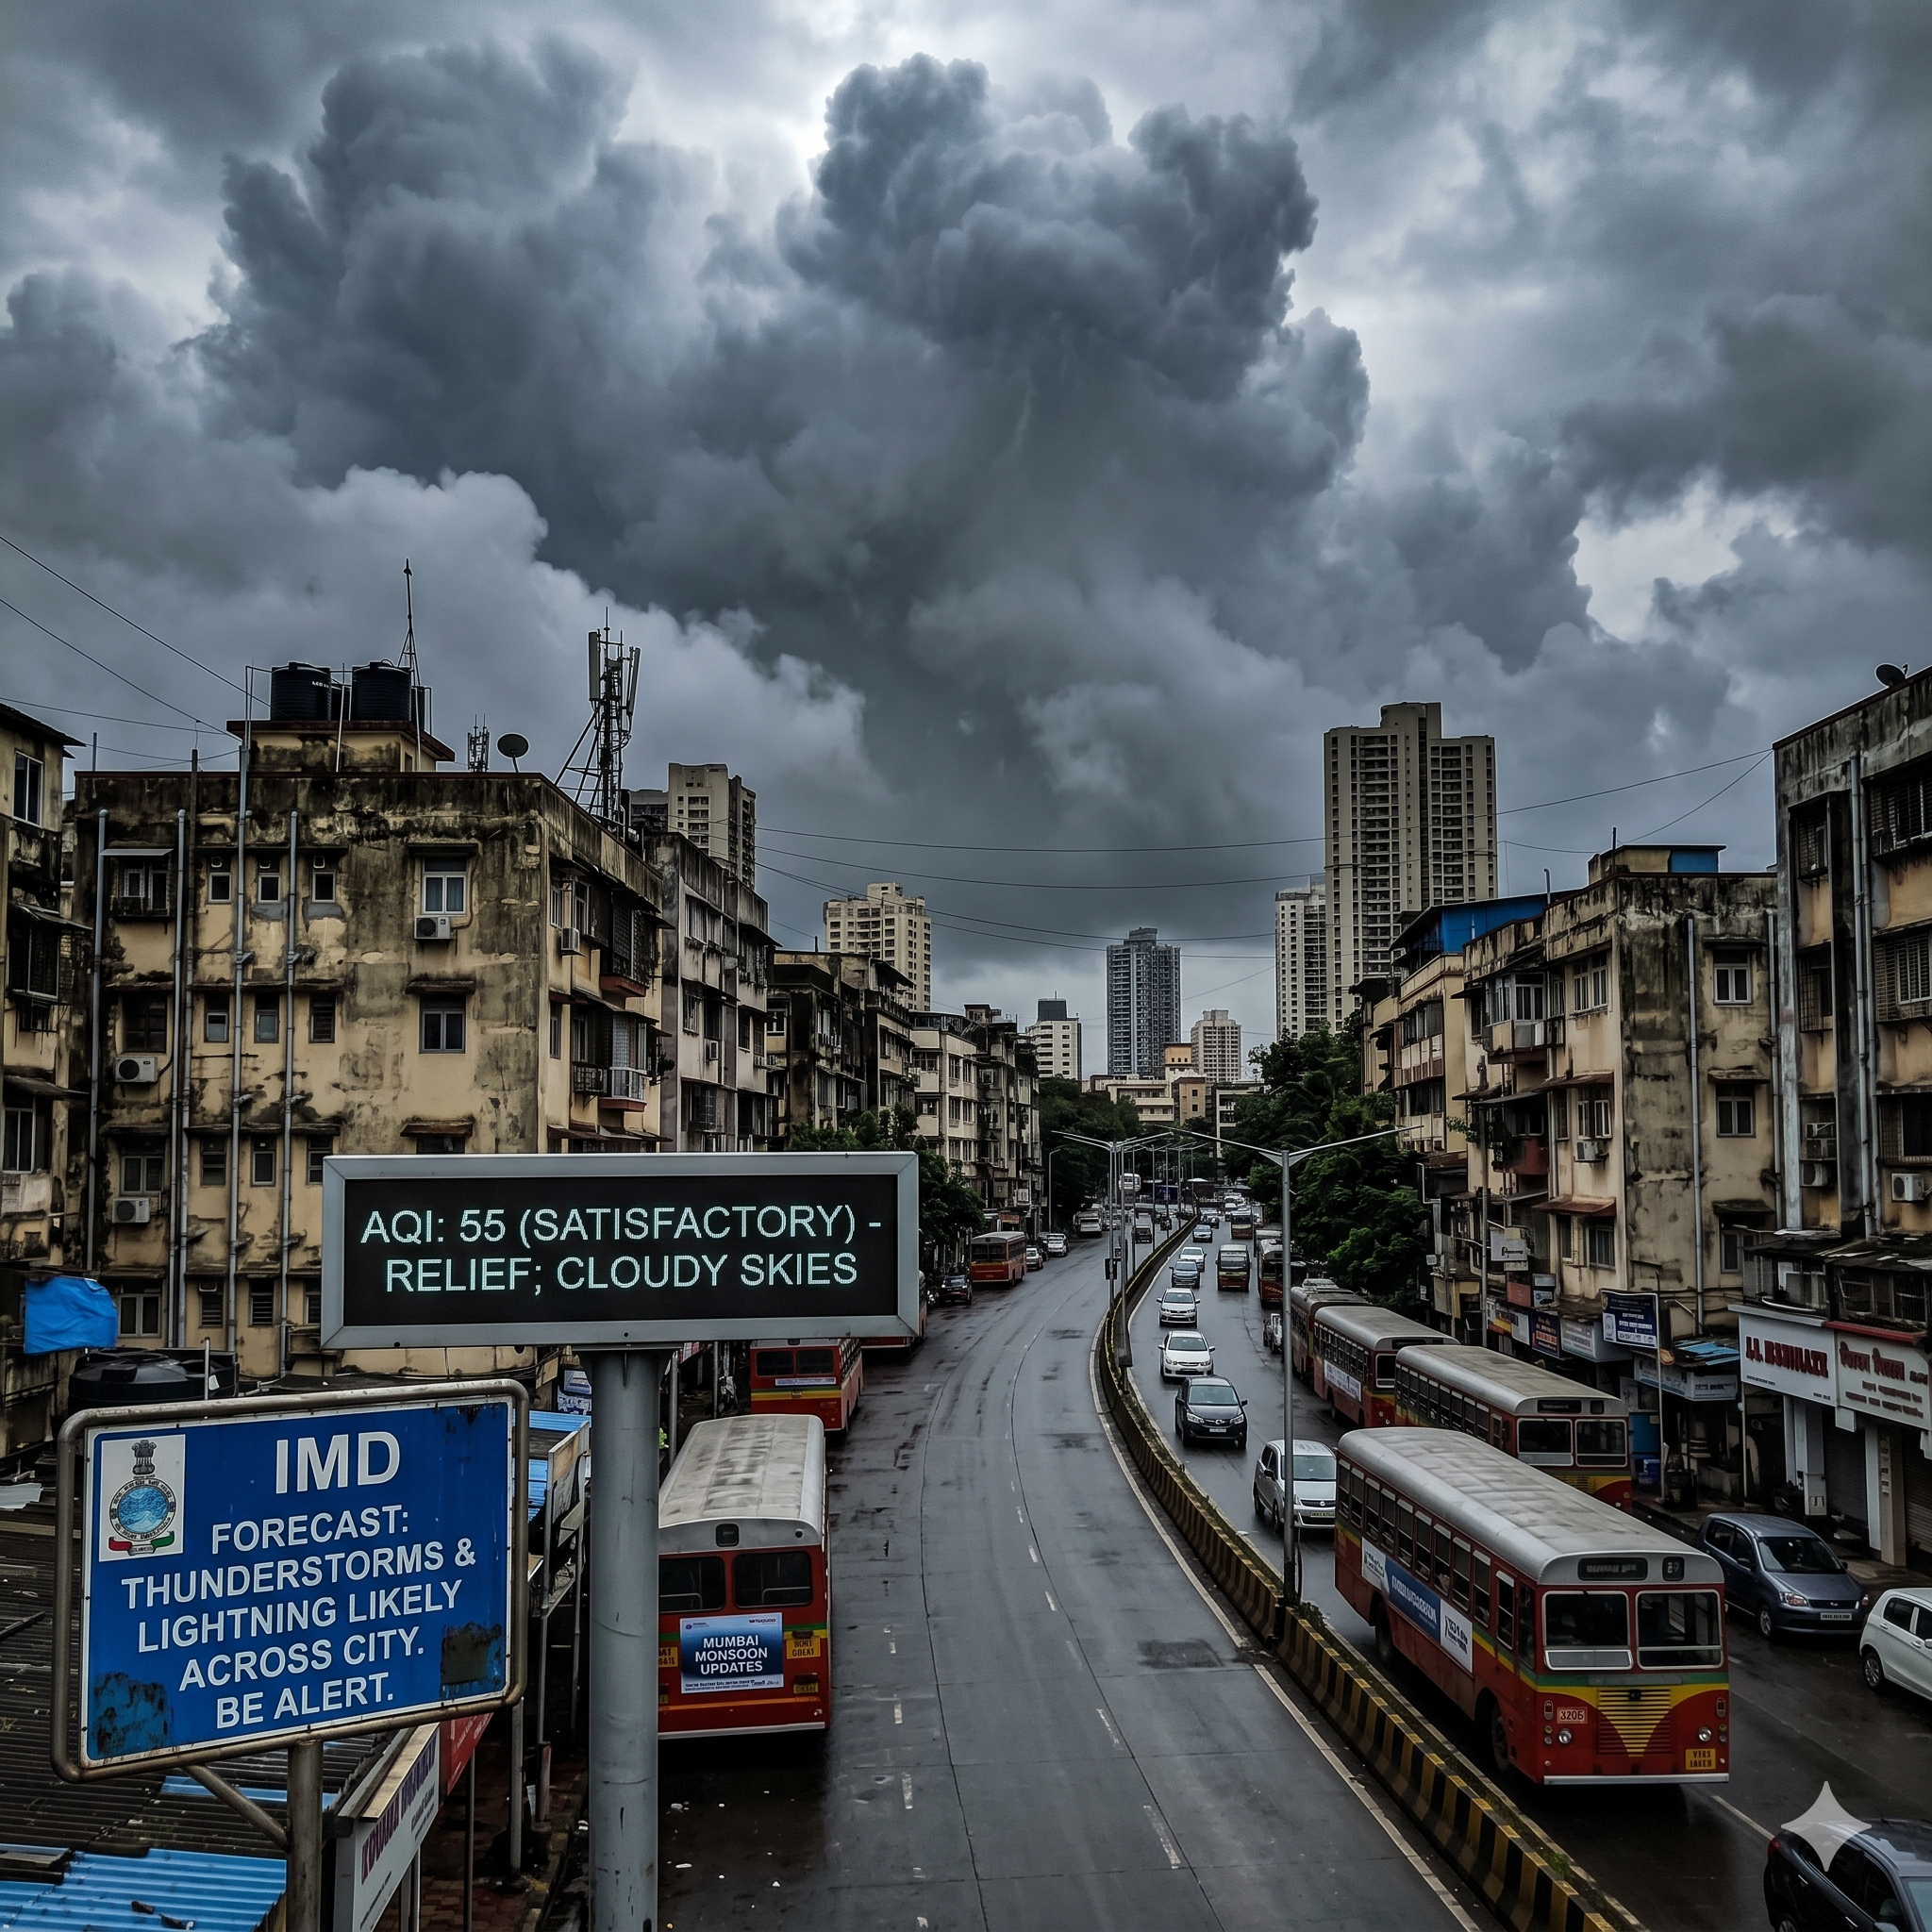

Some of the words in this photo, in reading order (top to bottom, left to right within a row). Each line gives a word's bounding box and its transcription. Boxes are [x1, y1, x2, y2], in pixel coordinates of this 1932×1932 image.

[359, 1209, 444, 1245] AQI:
[459, 1208, 507, 1242] 55
[519, 1204, 856, 1249] (SATISFACTORY)
[386, 1257, 541, 1296] RELIEF;
[557, 1254, 728, 1290] CLOUDY
[740, 1252, 858, 1287] SKIES
[275, 1431, 401, 1494] IMD
[211, 1504, 409, 1555] FORECAST:
[121, 1541, 444, 1609] THUNDERSTORMS
[454, 1538, 476, 1567] &
[139, 1593, 337, 1653] LIGHTNING
[349, 1579, 462, 1624] LIKELY
[178, 1639, 332, 1691] ACROSS
[343, 1625, 425, 1665] CITY.
[695, 1647, 768, 1662] MONSOON
[700, 1660, 763, 1675] UPDATES
[703, 1635, 758, 1649] MUMBAI
[216, 1691, 264, 1729] BE
[273, 1672, 393, 1720] ALERT.
